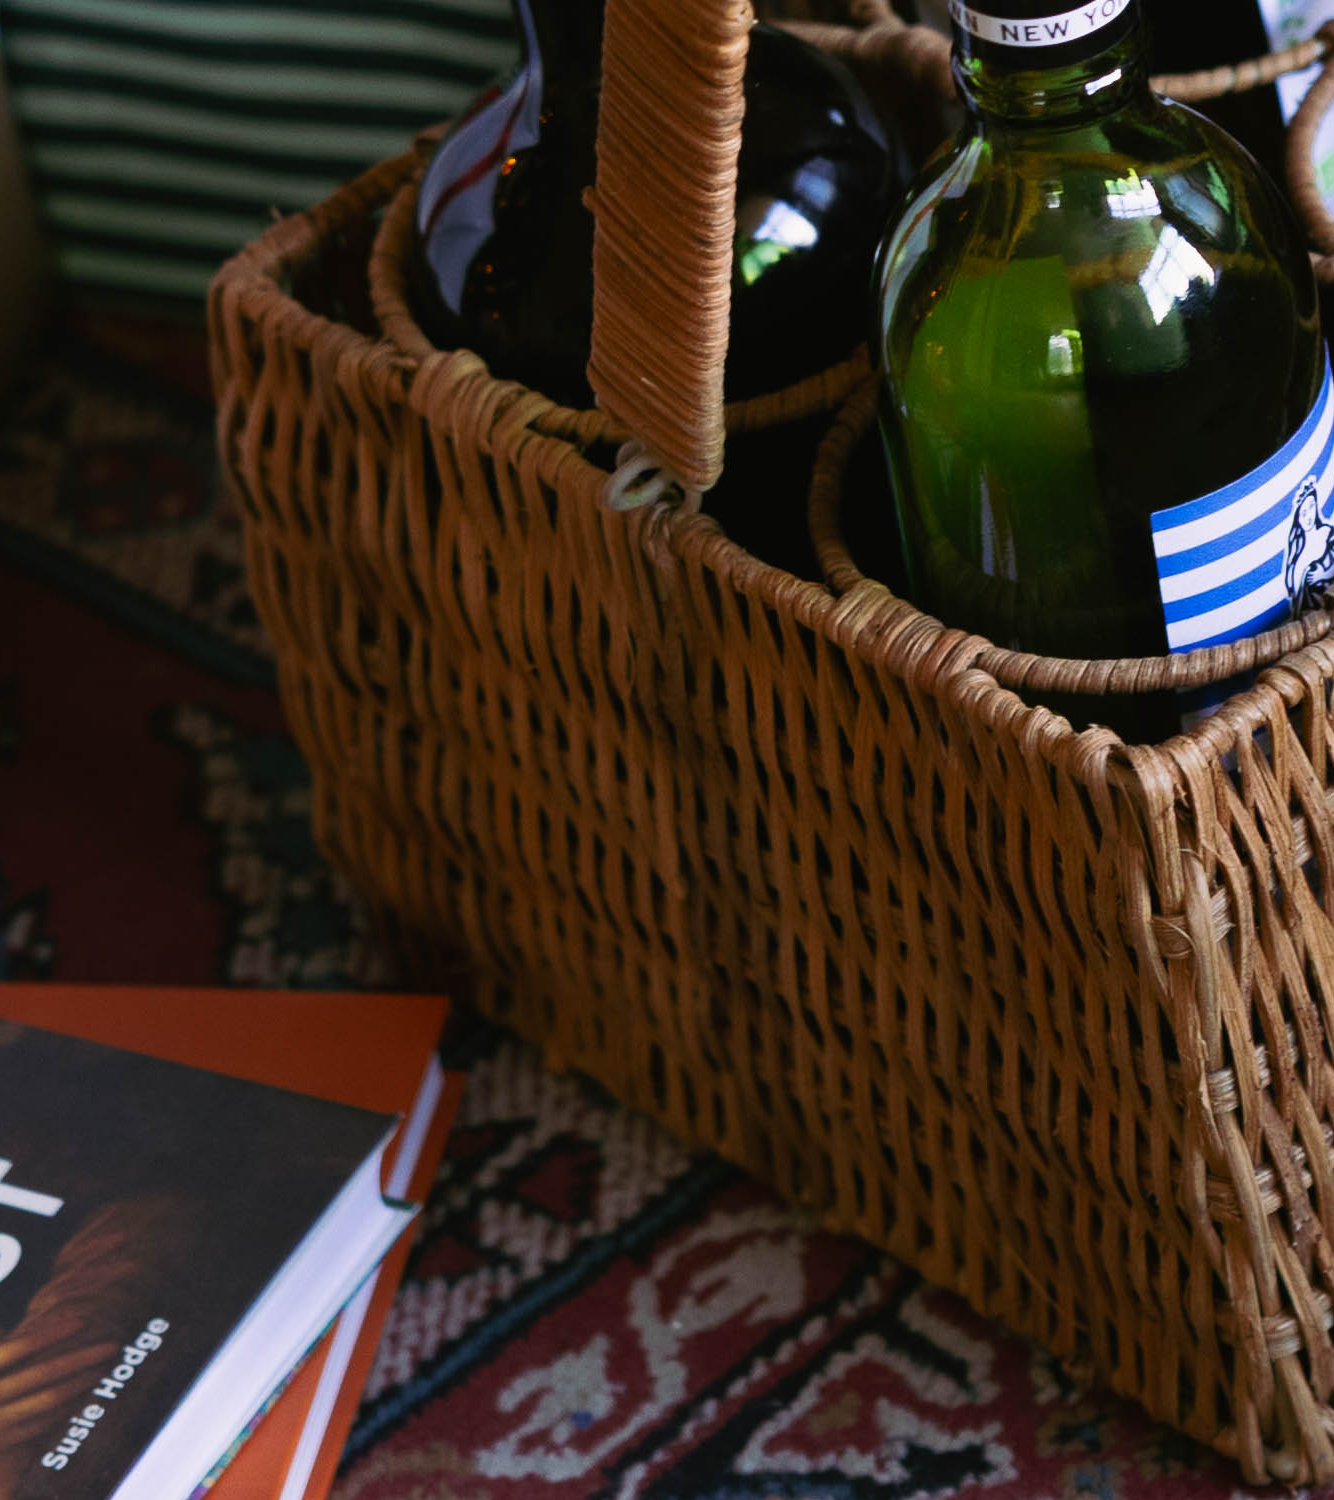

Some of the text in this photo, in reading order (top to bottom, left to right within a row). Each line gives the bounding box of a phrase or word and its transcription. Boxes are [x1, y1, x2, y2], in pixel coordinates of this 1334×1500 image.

[1000, 19, 1070, 43] NEW
[41, 1317, 170, 1471] Susie Hodge
